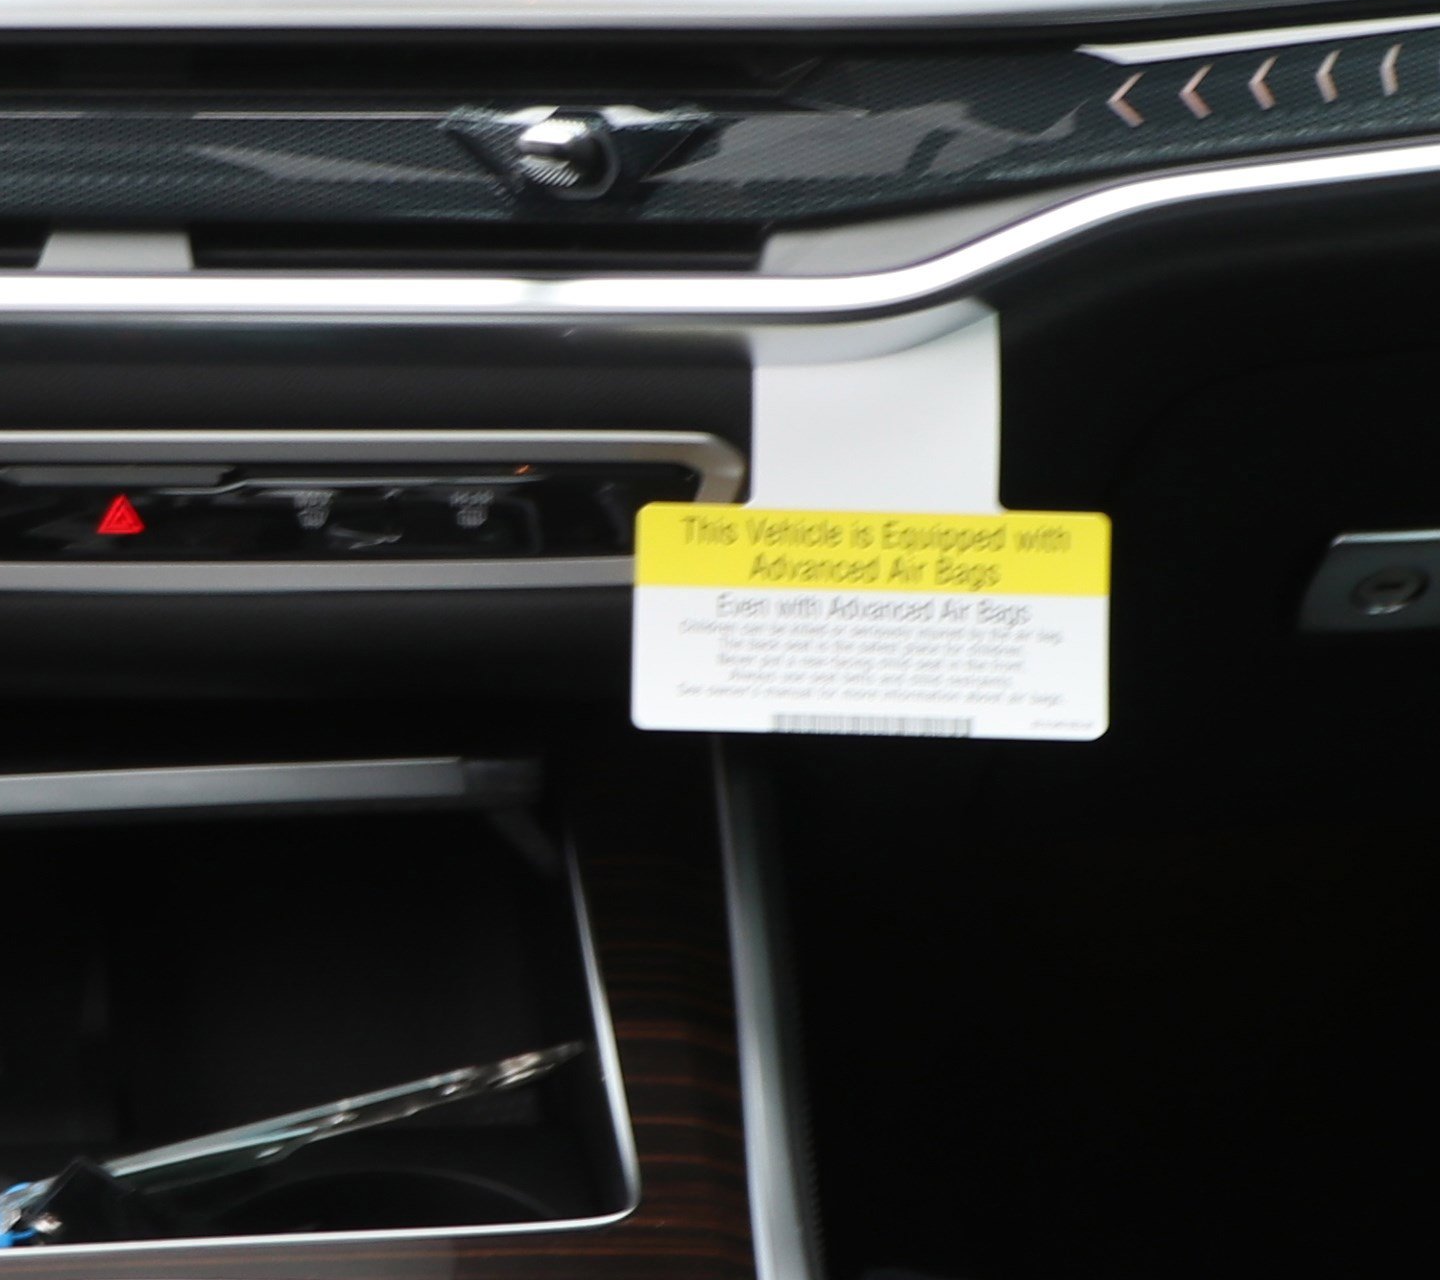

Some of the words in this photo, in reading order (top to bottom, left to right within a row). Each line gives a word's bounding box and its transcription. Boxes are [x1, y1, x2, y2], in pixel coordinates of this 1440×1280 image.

[681, 515, 739, 546] This
[745, 517, 843, 549] Vehicle
[849, 520, 875, 549] is
[881, 520, 1007, 556] Equipped
[1014, 524, 1071, 553] with
[749, 552, 880, 584] Advanced
[887, 555, 928, 584] Air
[934, 556, 1002, 592] Bags
[717, 592, 769, 618] Even
[777, 593, 822, 618] with
[826, 595, 935, 622] Advanced
[938, 598, 972, 621] Air
[977, 599, 1034, 626] Bags
